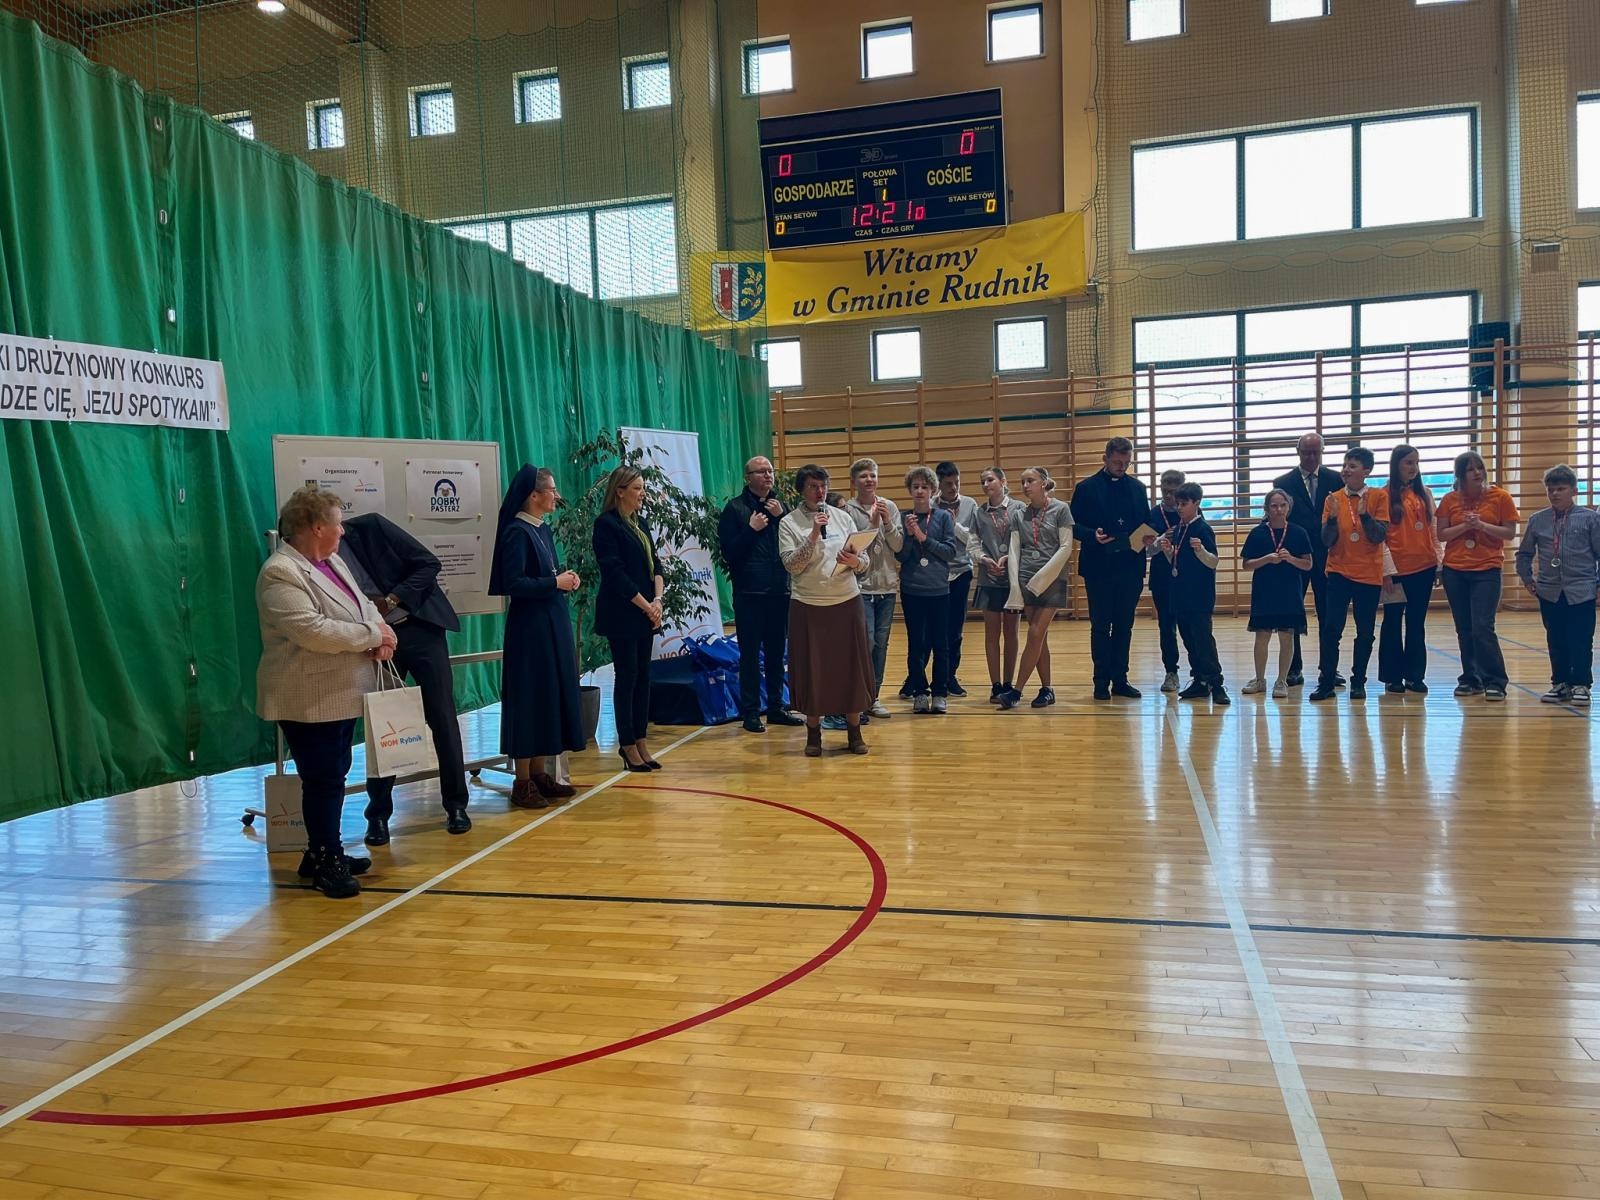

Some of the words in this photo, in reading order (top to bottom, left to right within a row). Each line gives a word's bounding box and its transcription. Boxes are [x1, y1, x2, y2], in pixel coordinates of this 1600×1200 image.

[960, 131, 974, 155] 0
[779, 154, 792, 176] 0
[862, 168, 897, 179] POŁOWA
[927, 163, 973, 186] GOŚCIE
[872, 178, 888, 187] SET
[774, 179, 855, 203] GOSPODARZE
[881, 188, 888, 201] 1
[948, 195, 967, 203] STAN
[969, 191, 995, 201] SETÓW
[985, 199, 996, 213] 0
[774, 212, 793, 222] STAN
[793, 210, 818, 220] SETÓW
[776, 221, 785, 235] 0
[854, 229, 873, 237] CZAS
[881, 226, 899, 234] CZAS
[900, 224, 915, 232] GRY
[864, 247, 979, 277] Witamy
[793, 297, 816, 317] w
[827, 280, 931, 314] Gminie
[939, 262, 1050, 304] Rudnik
[15, 344, 126, 381] DRUŻYNOWY
[130, 359, 204, 390] KONKURS
[0, 383, 38, 411] DZE
[44, 386, 77, 418] CIĘ,
[83, 389, 124, 416] JEZU
[430, 496, 460, 506] DOBRY
[430, 505, 460, 513] PASTERZ
[380, 738, 399, 748] WOM
[399, 734, 422, 745] Rybnik
[270, 819, 288, 827] WOM
[290, 819, 305, 827] Ryb
